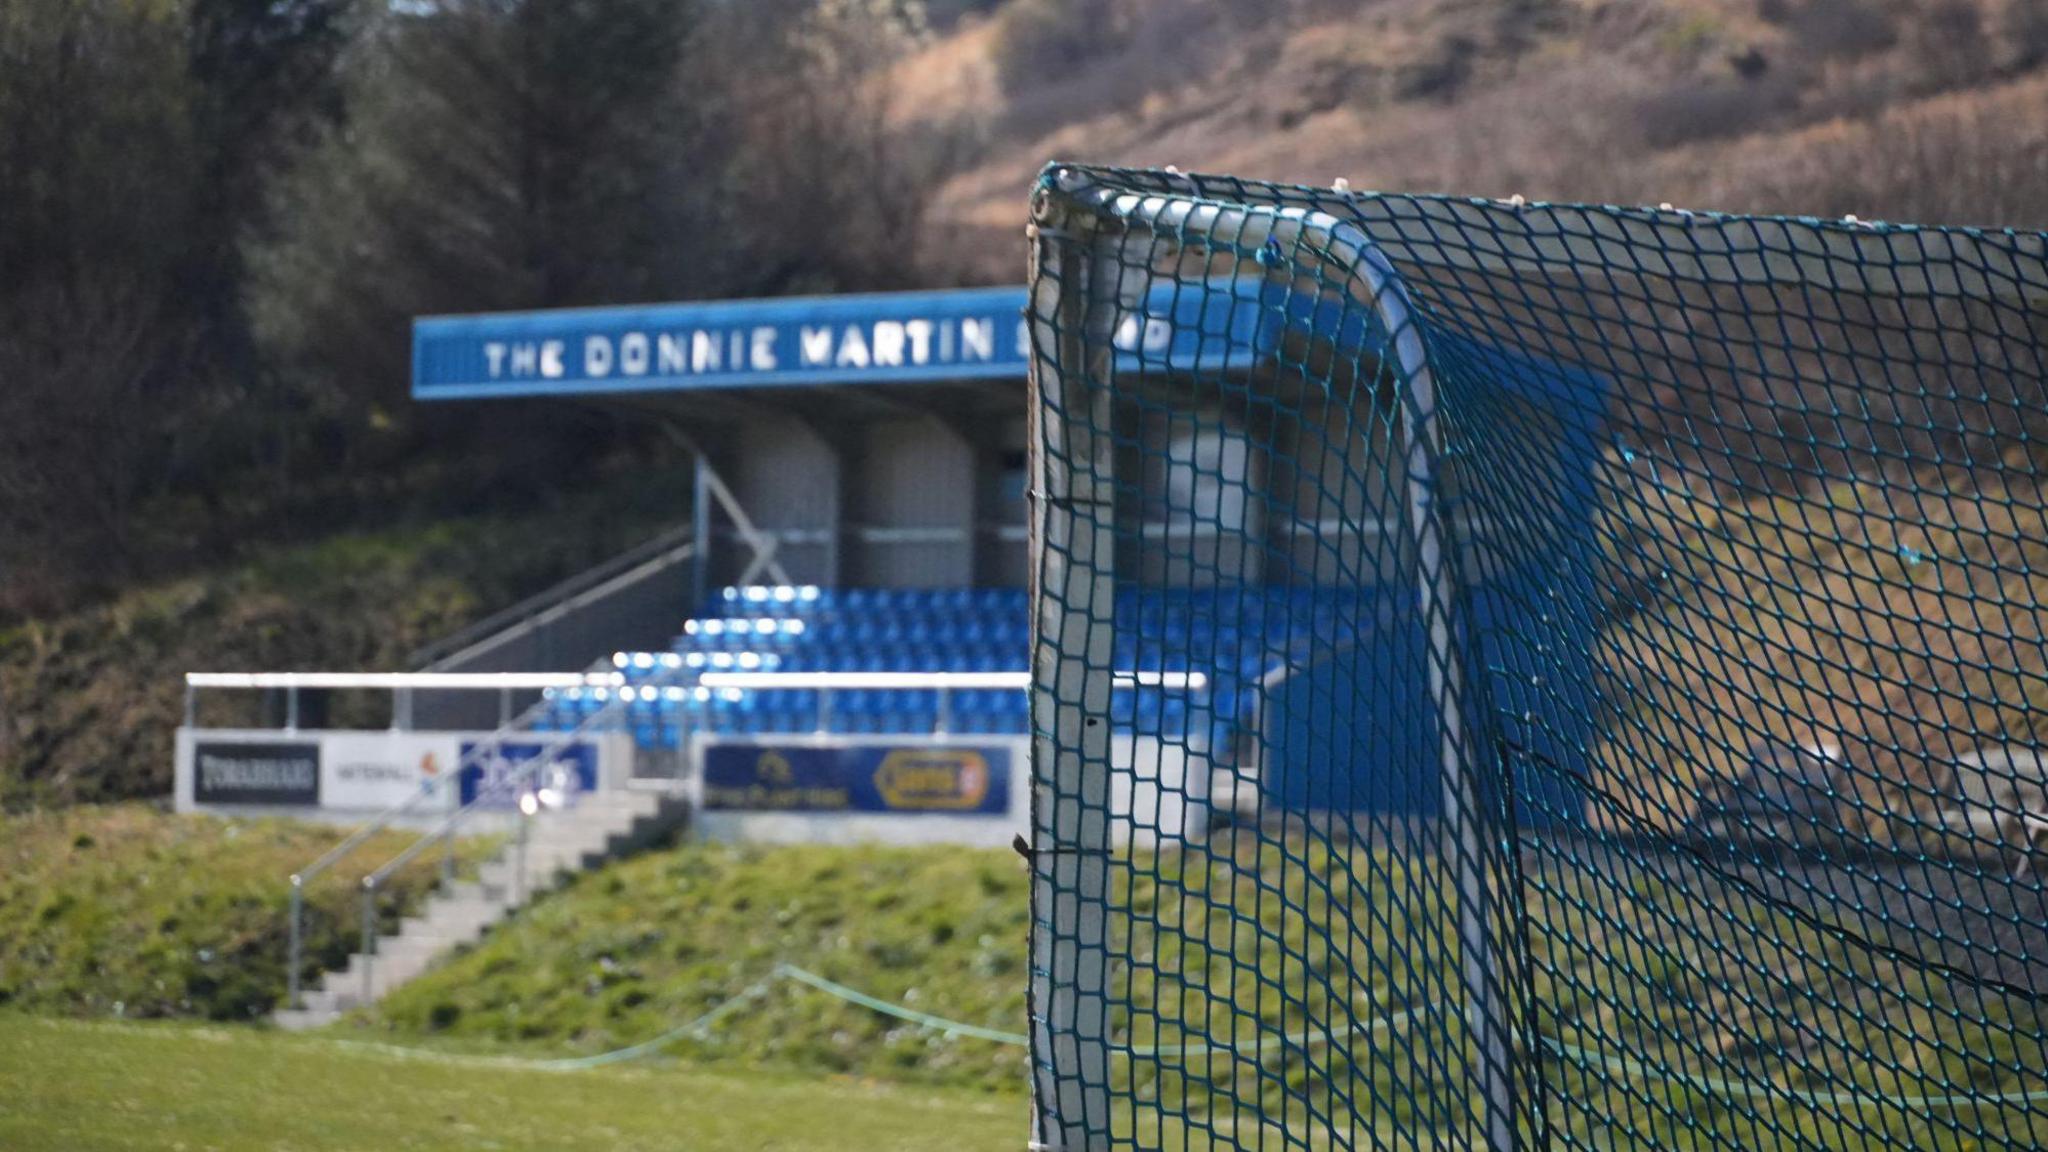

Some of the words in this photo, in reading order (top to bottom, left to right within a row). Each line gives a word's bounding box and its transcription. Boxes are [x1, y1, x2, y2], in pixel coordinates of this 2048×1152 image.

[484, 339, 565, 378] THE
[585, 327, 778, 376] DONNIE
[801, 316, 995, 368] MARTIN
